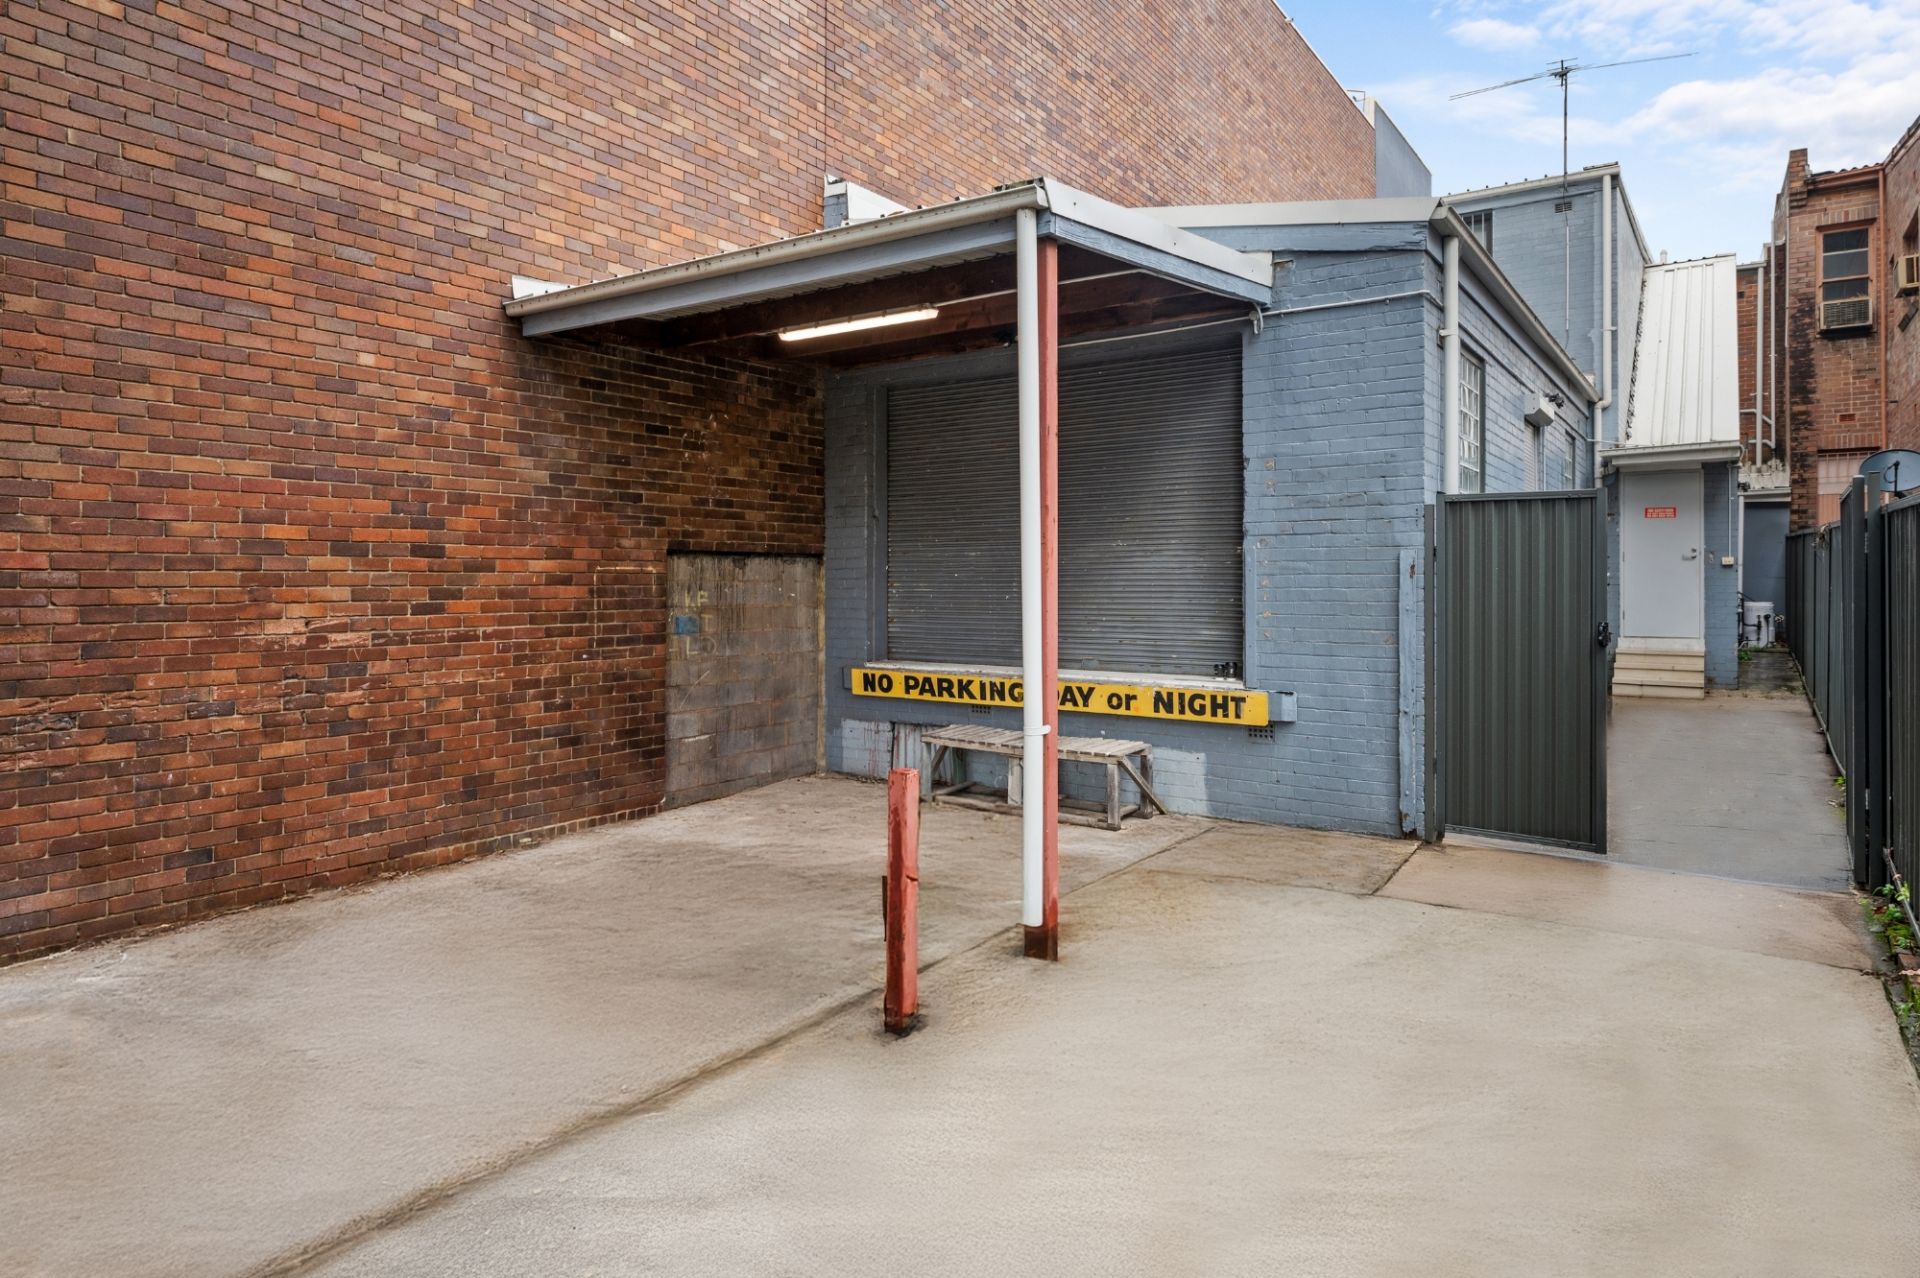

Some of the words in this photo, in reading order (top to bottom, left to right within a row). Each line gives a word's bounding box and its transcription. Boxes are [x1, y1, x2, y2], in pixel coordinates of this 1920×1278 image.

[863, 672, 893, 693] NO
[904, 675, 1024, 702] PARKING
[1057, 685, 1096, 707] AY
[1106, 692, 1137, 711] or
[1153, 690, 1246, 719] NIGHT
